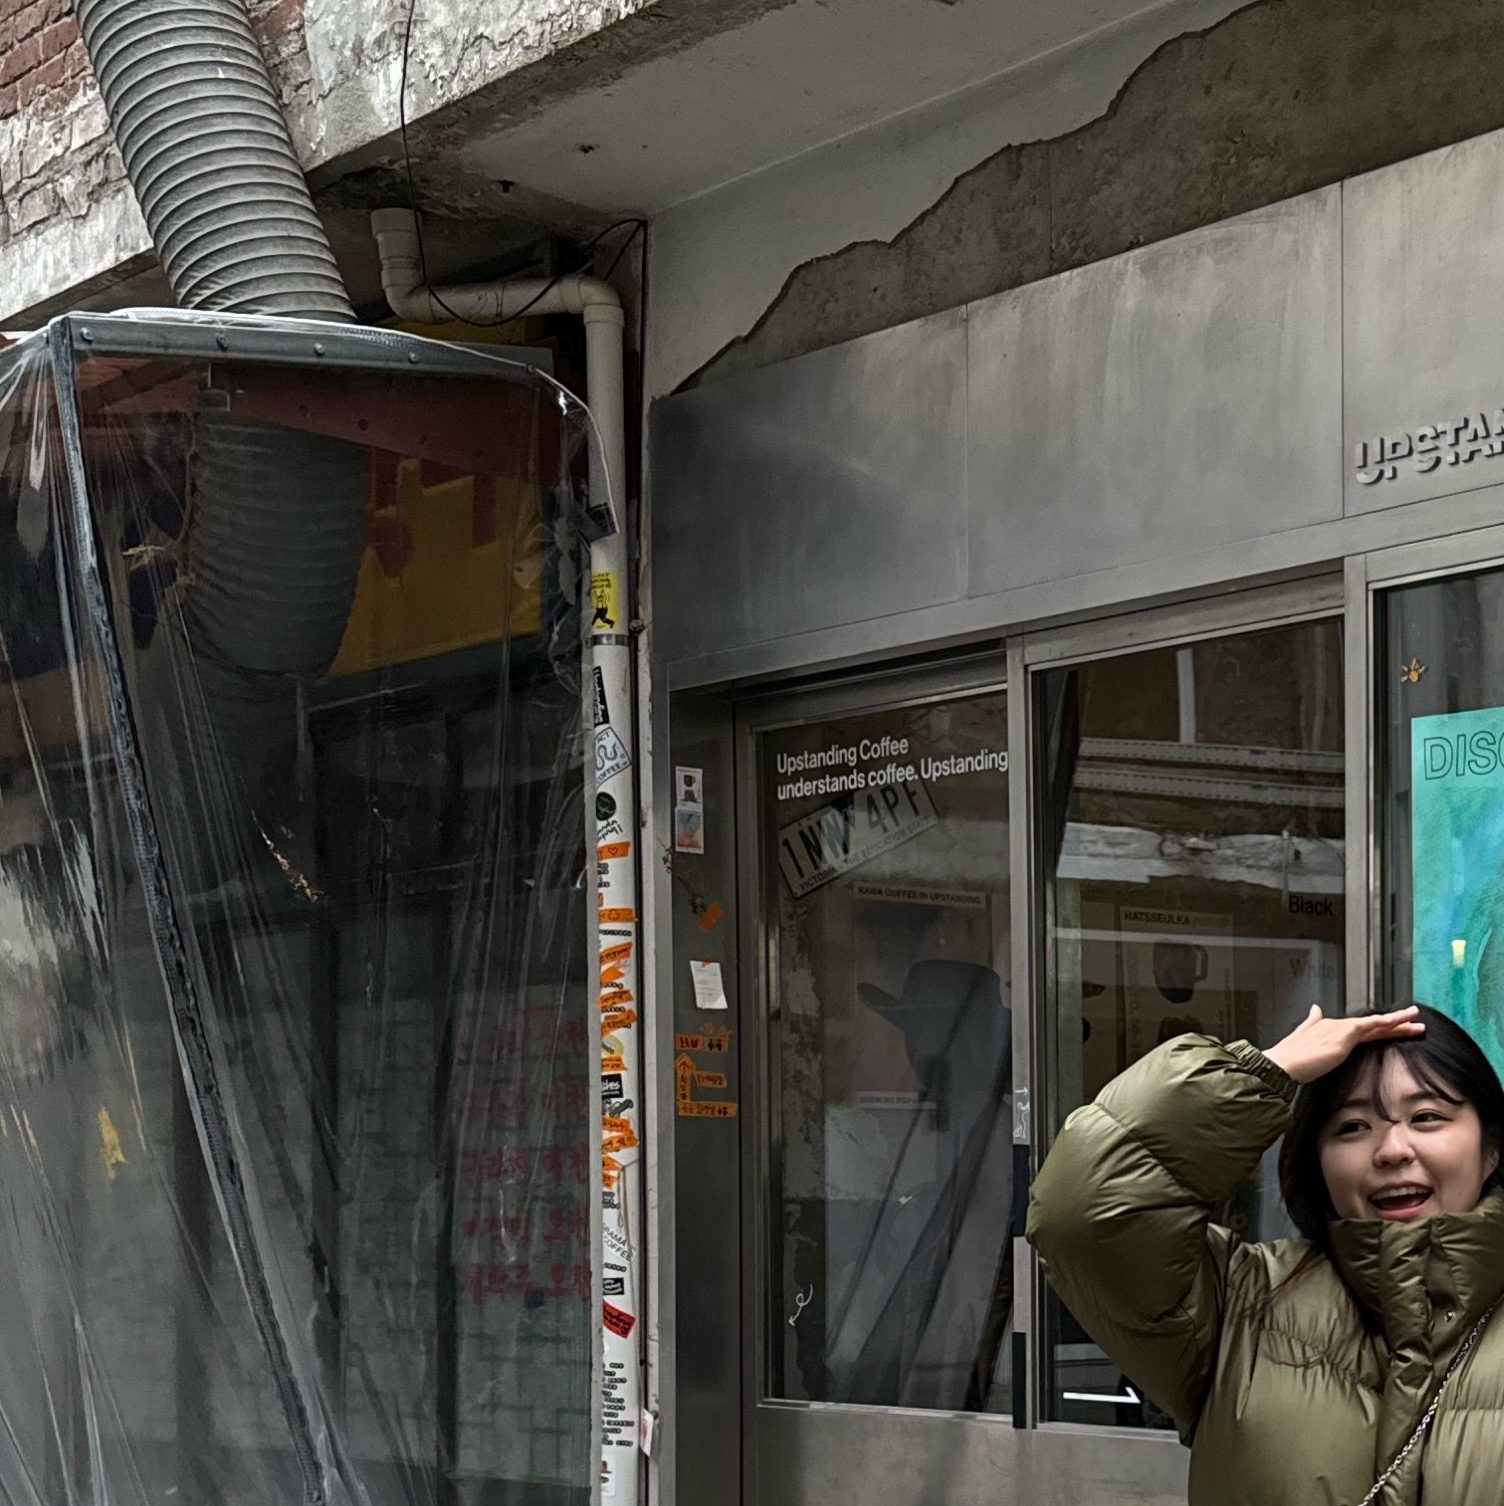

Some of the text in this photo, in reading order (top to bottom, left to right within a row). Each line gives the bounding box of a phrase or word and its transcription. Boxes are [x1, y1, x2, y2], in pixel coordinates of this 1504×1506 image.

[776, 736, 909, 776] Upstanding Coffee
[777, 748, 1009, 801] understands coffee. Upstanding
[1288, 894, 1334, 917] Black
